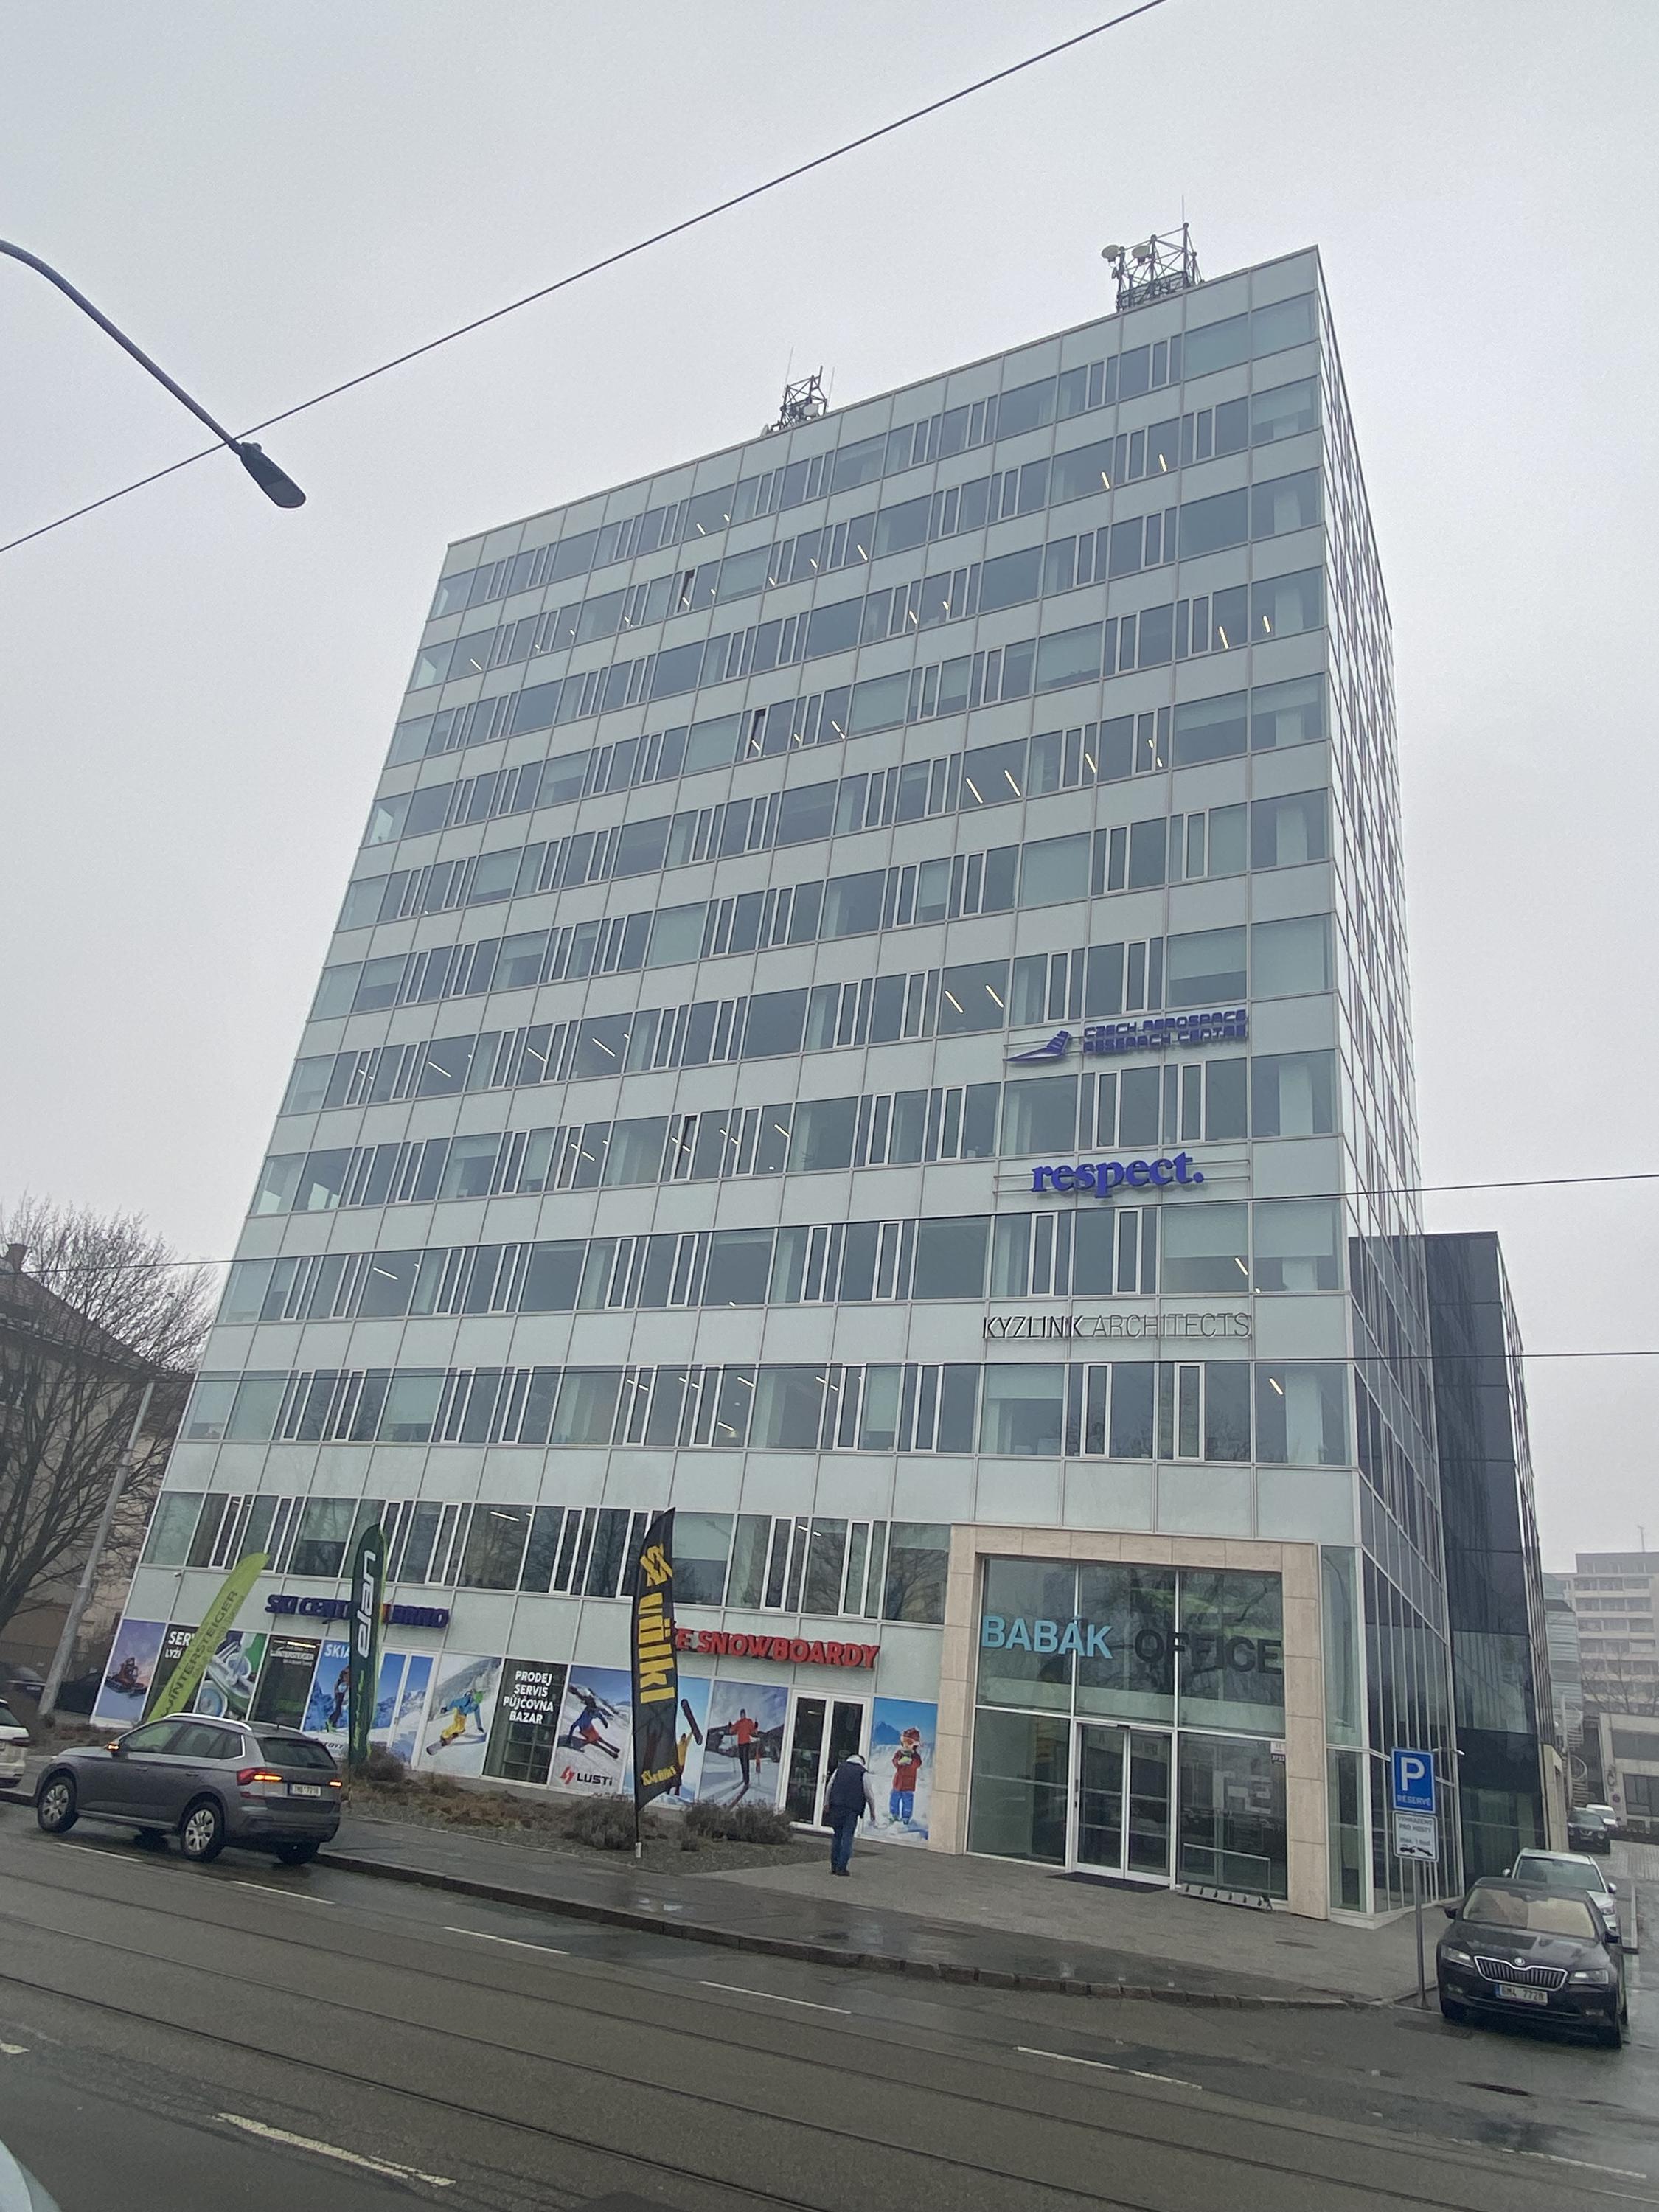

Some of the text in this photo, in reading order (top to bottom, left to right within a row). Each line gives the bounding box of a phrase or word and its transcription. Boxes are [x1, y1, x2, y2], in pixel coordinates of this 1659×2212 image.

[1143, 1009, 1247, 1032] AEROSPACE
[1032, 1152, 1205, 1199] respect.
[982, 1312, 1252, 1339] KYZLINK ARCHITECTS
[265, 1593, 299, 1615] SKI
[357, 1550, 377, 1658] elan
[167, 1630, 195, 1646] SER
[981, 1614, 1283, 1676] BABÁK OFFICE
[160, 1590, 238, 1718] WINTERSTEIGER
[324, 1644, 350, 1658] SKIA
[696, 1630, 880, 1669] SNOWBOARDY
[515, 1670, 552, 1686] PRODEJ
[513, 1683, 549, 1697] SERVIS
[502, 1694, 554, 1712] PŮJČOVNA
[509, 1710, 543, 1725] BAZAR
[324, 1742, 344, 1750] COTT
[1401, 1756, 1425, 1792] P
